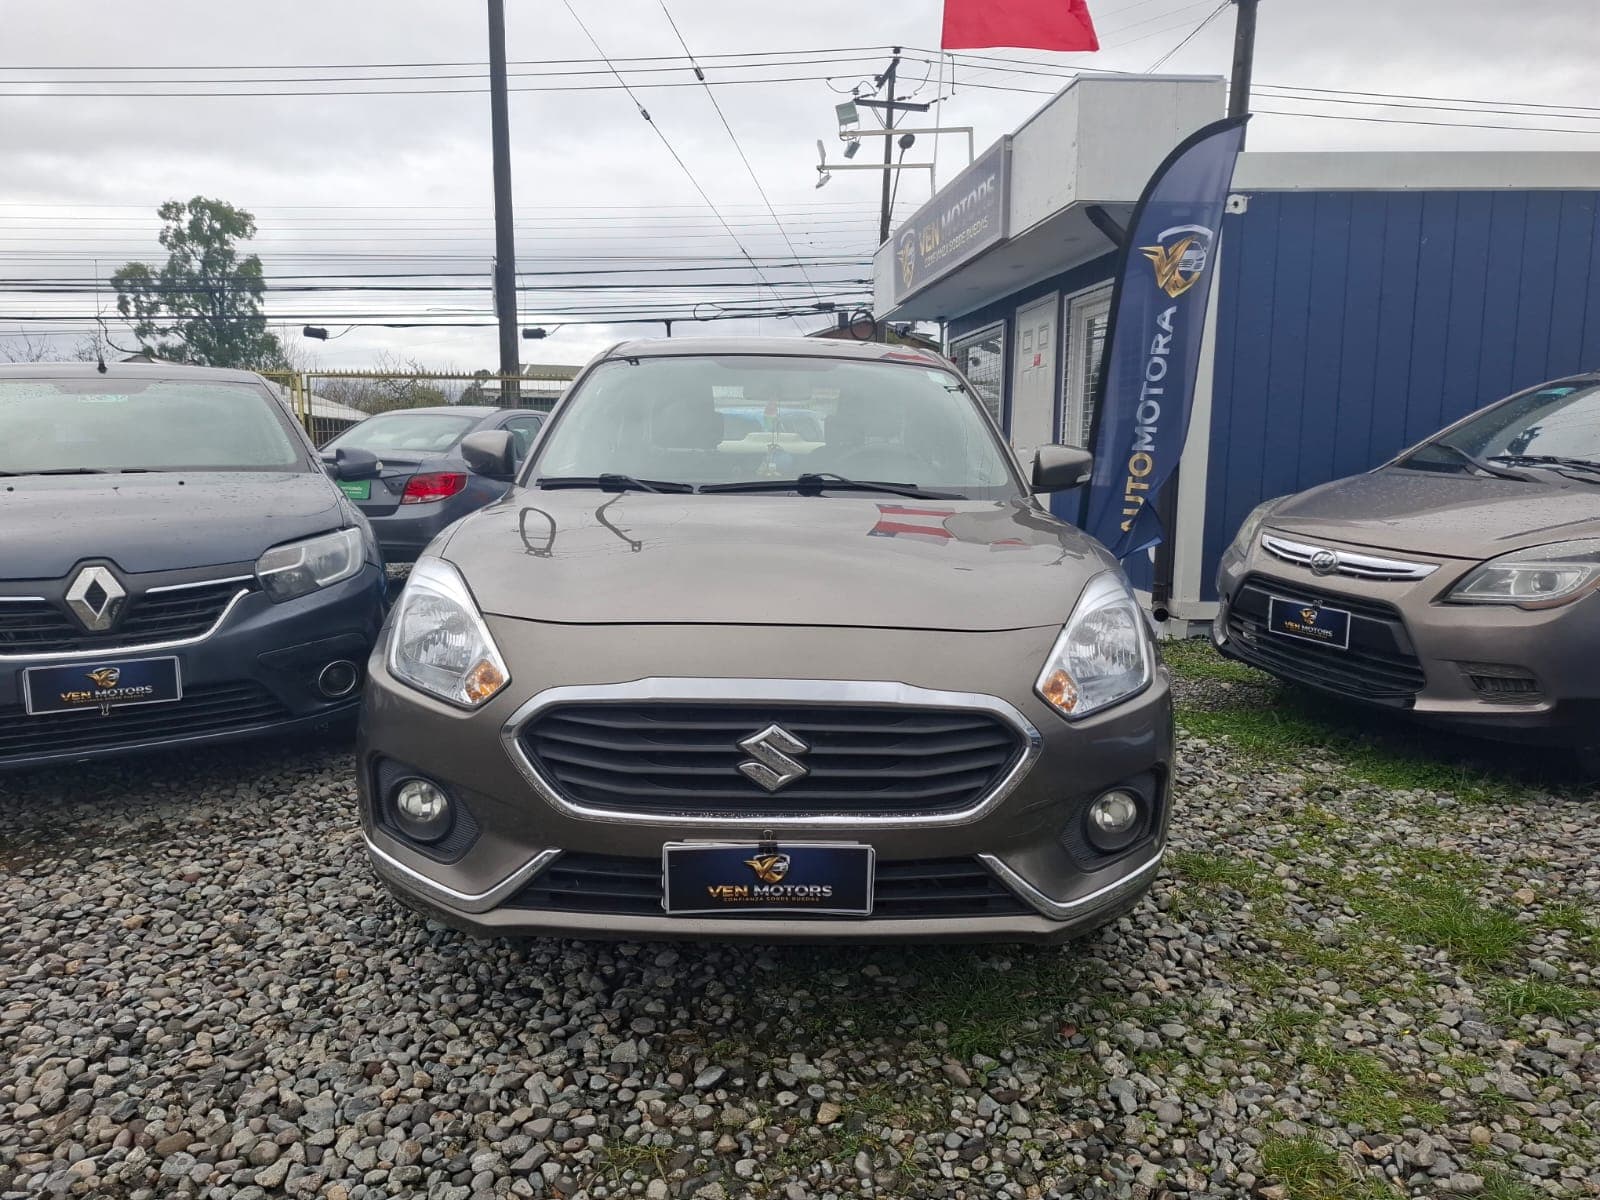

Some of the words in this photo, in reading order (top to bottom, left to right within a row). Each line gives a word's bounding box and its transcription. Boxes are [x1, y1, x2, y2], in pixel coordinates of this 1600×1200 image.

[919, 219, 940, 256] VEN
[1284, 620, 1300, 630] VEN
[1301, 624, 1334, 637] MOTORS
[60, 690, 91, 701] VEN
[94, 685, 153, 698] MOTORS
[707, 885, 748, 897] VEN
[753, 885, 833, 897] MOTORS
